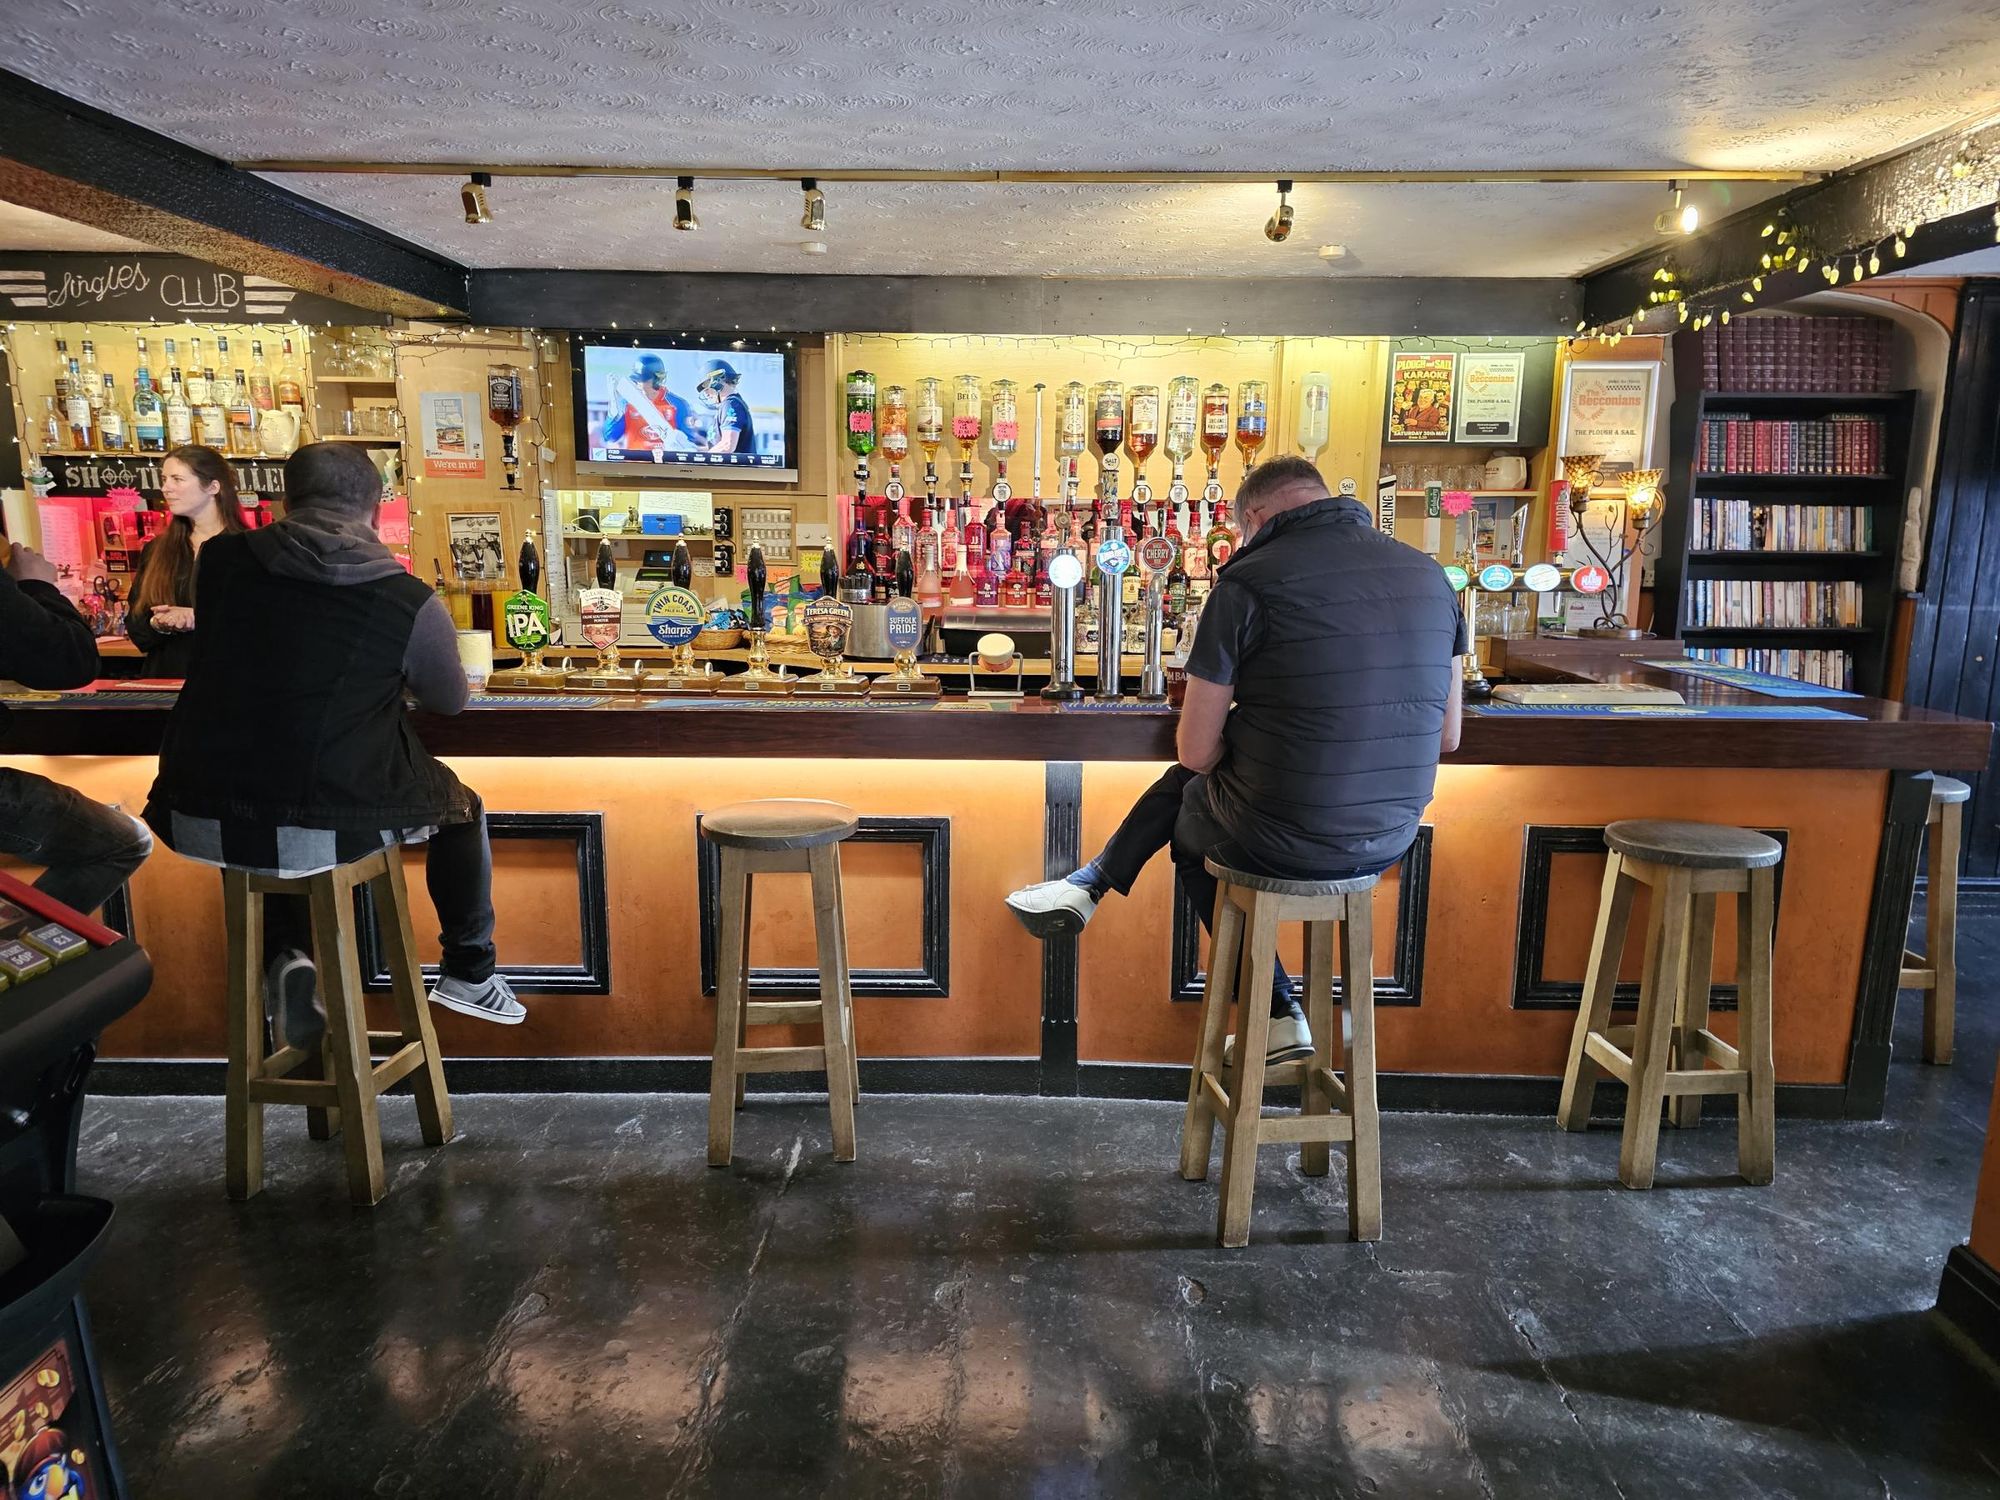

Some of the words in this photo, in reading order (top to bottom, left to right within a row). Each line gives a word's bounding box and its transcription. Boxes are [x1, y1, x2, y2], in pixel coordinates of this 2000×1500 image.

[47, 262, 150, 309] Singles
[160, 273, 240, 308] CLUB
[1397, 360, 1426, 370] PLOUGH
[1434, 360, 1451, 370] SAIL
[1403, 371, 1449, 380] KARAOKE
[1470, 375, 1515, 383] Becconians
[957, 392, 978, 400] BELL'S
[1579, 395, 1641, 406] Becconians
[433, 460, 457, 468] We're
[1382, 494, 1394, 537] CARLING
[1146, 549, 1169, 558] CHERRY
[652, 594, 671, 614] TWIN
[672, 594, 696, 615] COAST
[806, 607, 828, 616] TERESA
[829, 607, 850, 617] GREEN
[506, 612, 547, 638] IPA
[889, 616, 917, 624] SUFFOLK
[658, 624, 693, 637] Sharp's
[889, 624, 917, 634] PRIDE
